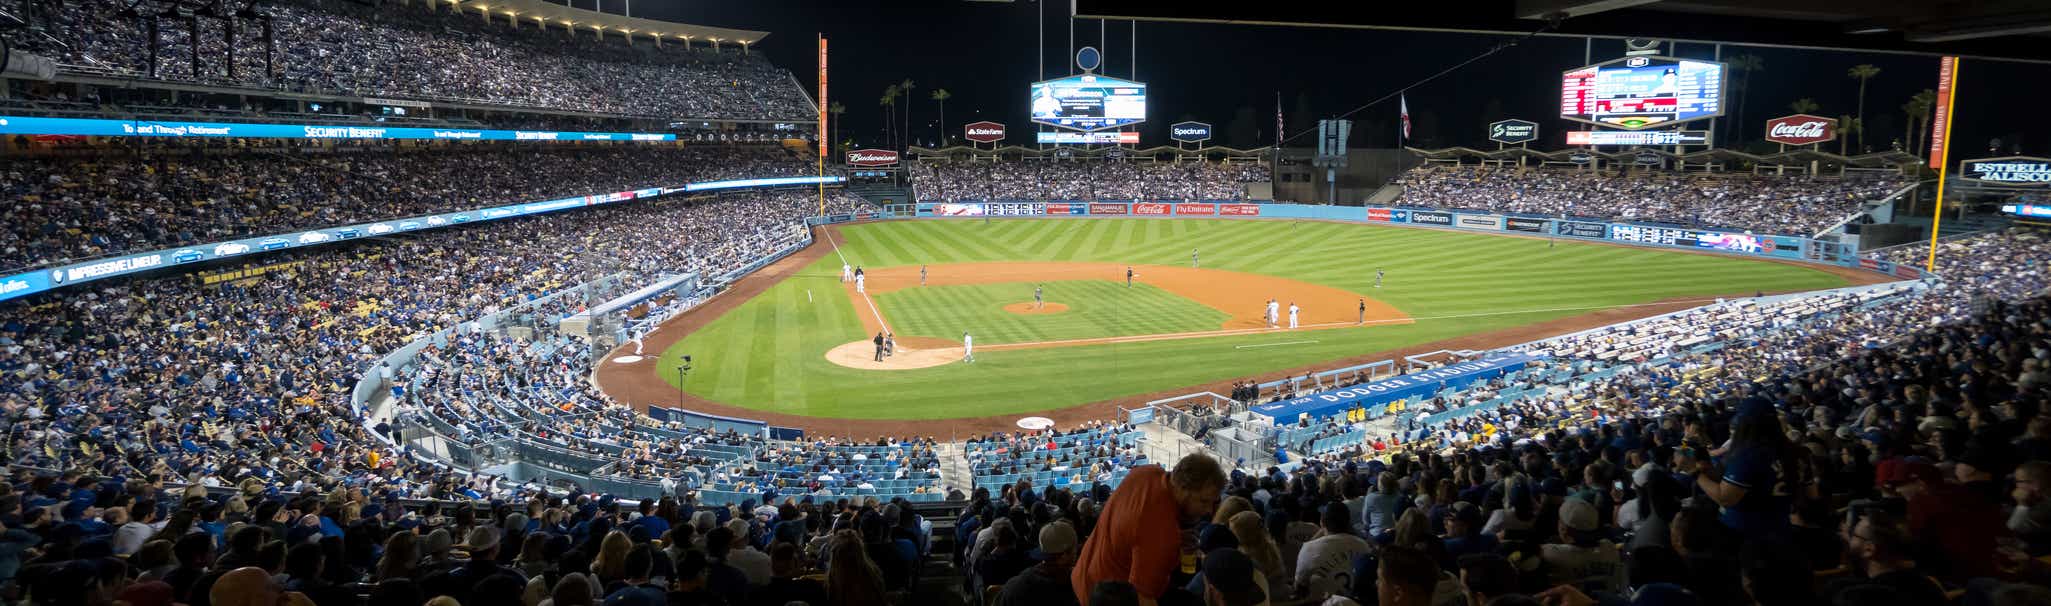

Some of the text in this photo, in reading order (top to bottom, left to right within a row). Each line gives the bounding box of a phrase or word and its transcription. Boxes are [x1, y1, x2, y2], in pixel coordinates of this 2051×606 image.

[304, 127, 348, 138] SECURITY
[1174, 128, 1206, 136] Spectrum
[849, 154, 896, 162] Budweiser
[1974, 163, 2051, 172] ESTRELL
[1981, 172, 2051, 181] JALISCO
[1413, 213, 1448, 223] Spectrum
[1320, 380, 1410, 402] DODGER
